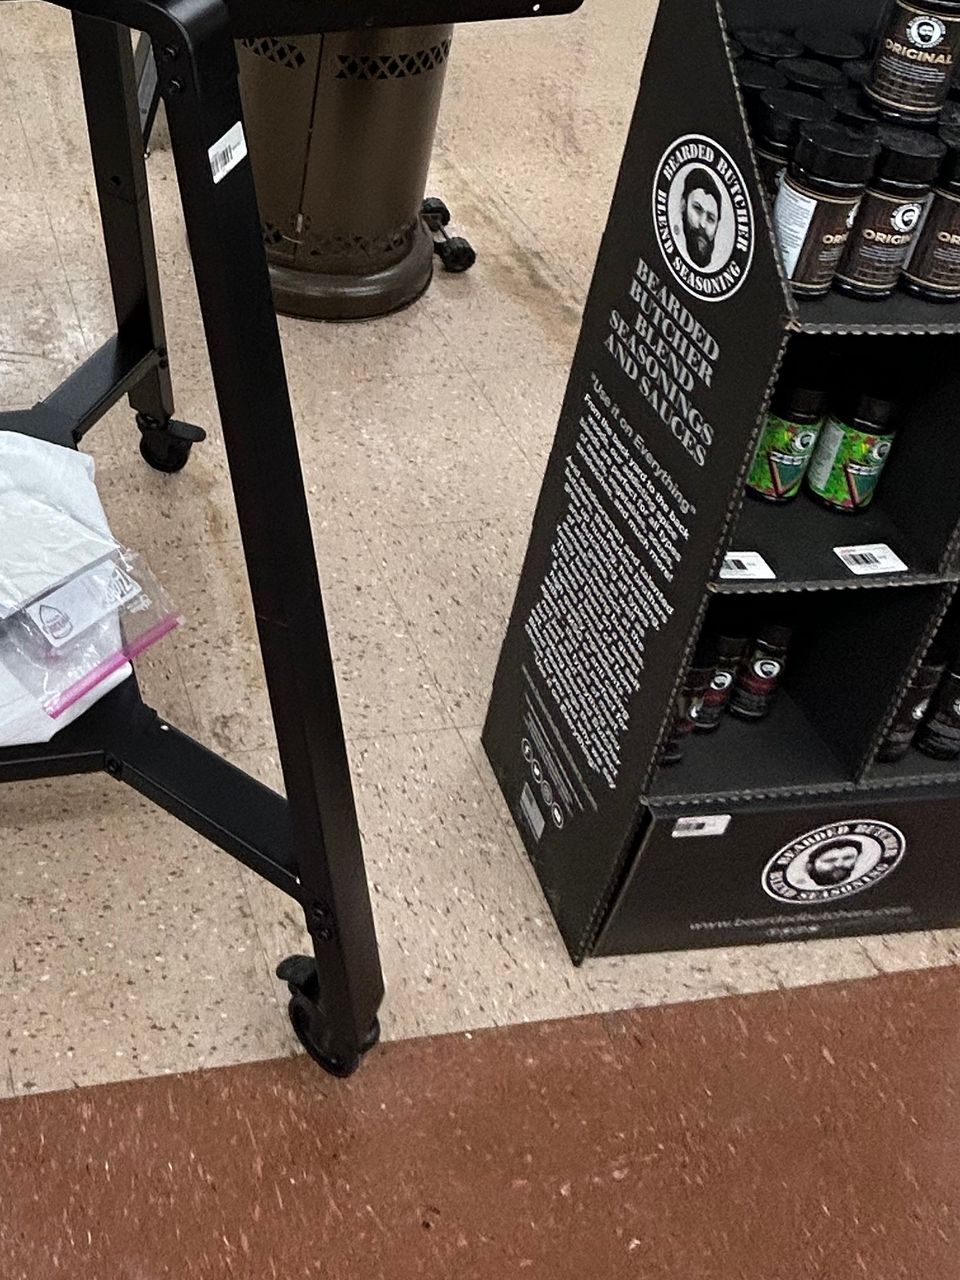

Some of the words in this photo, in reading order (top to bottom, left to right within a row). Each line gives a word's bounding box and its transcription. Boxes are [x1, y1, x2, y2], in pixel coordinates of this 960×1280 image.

[885, 39, 953, 65] ORIGINAL
[656, 189, 675, 255] BLEND
[672, 258, 741, 296] SEASONING
[662, 142, 716, 185] BEARDED
[716, 155, 751, 253] BUTCHER
[629, 276, 714, 389] BUTCHER
[635, 312, 695, 393] BLEND
[636, 257, 721, 362] BEARDED
[603, 332, 639, 382] AND
[638, 374, 707, 468] SAUCES
[608, 308, 715, 446] SEASONINGS
[611, 404, 620, 420] it
[619, 417, 633, 438] on
[633, 434, 696, 514] Everything"
[611, 433, 630, 460] back
[628, 457, 648, 482] yard
[668, 510, 690, 540] back
